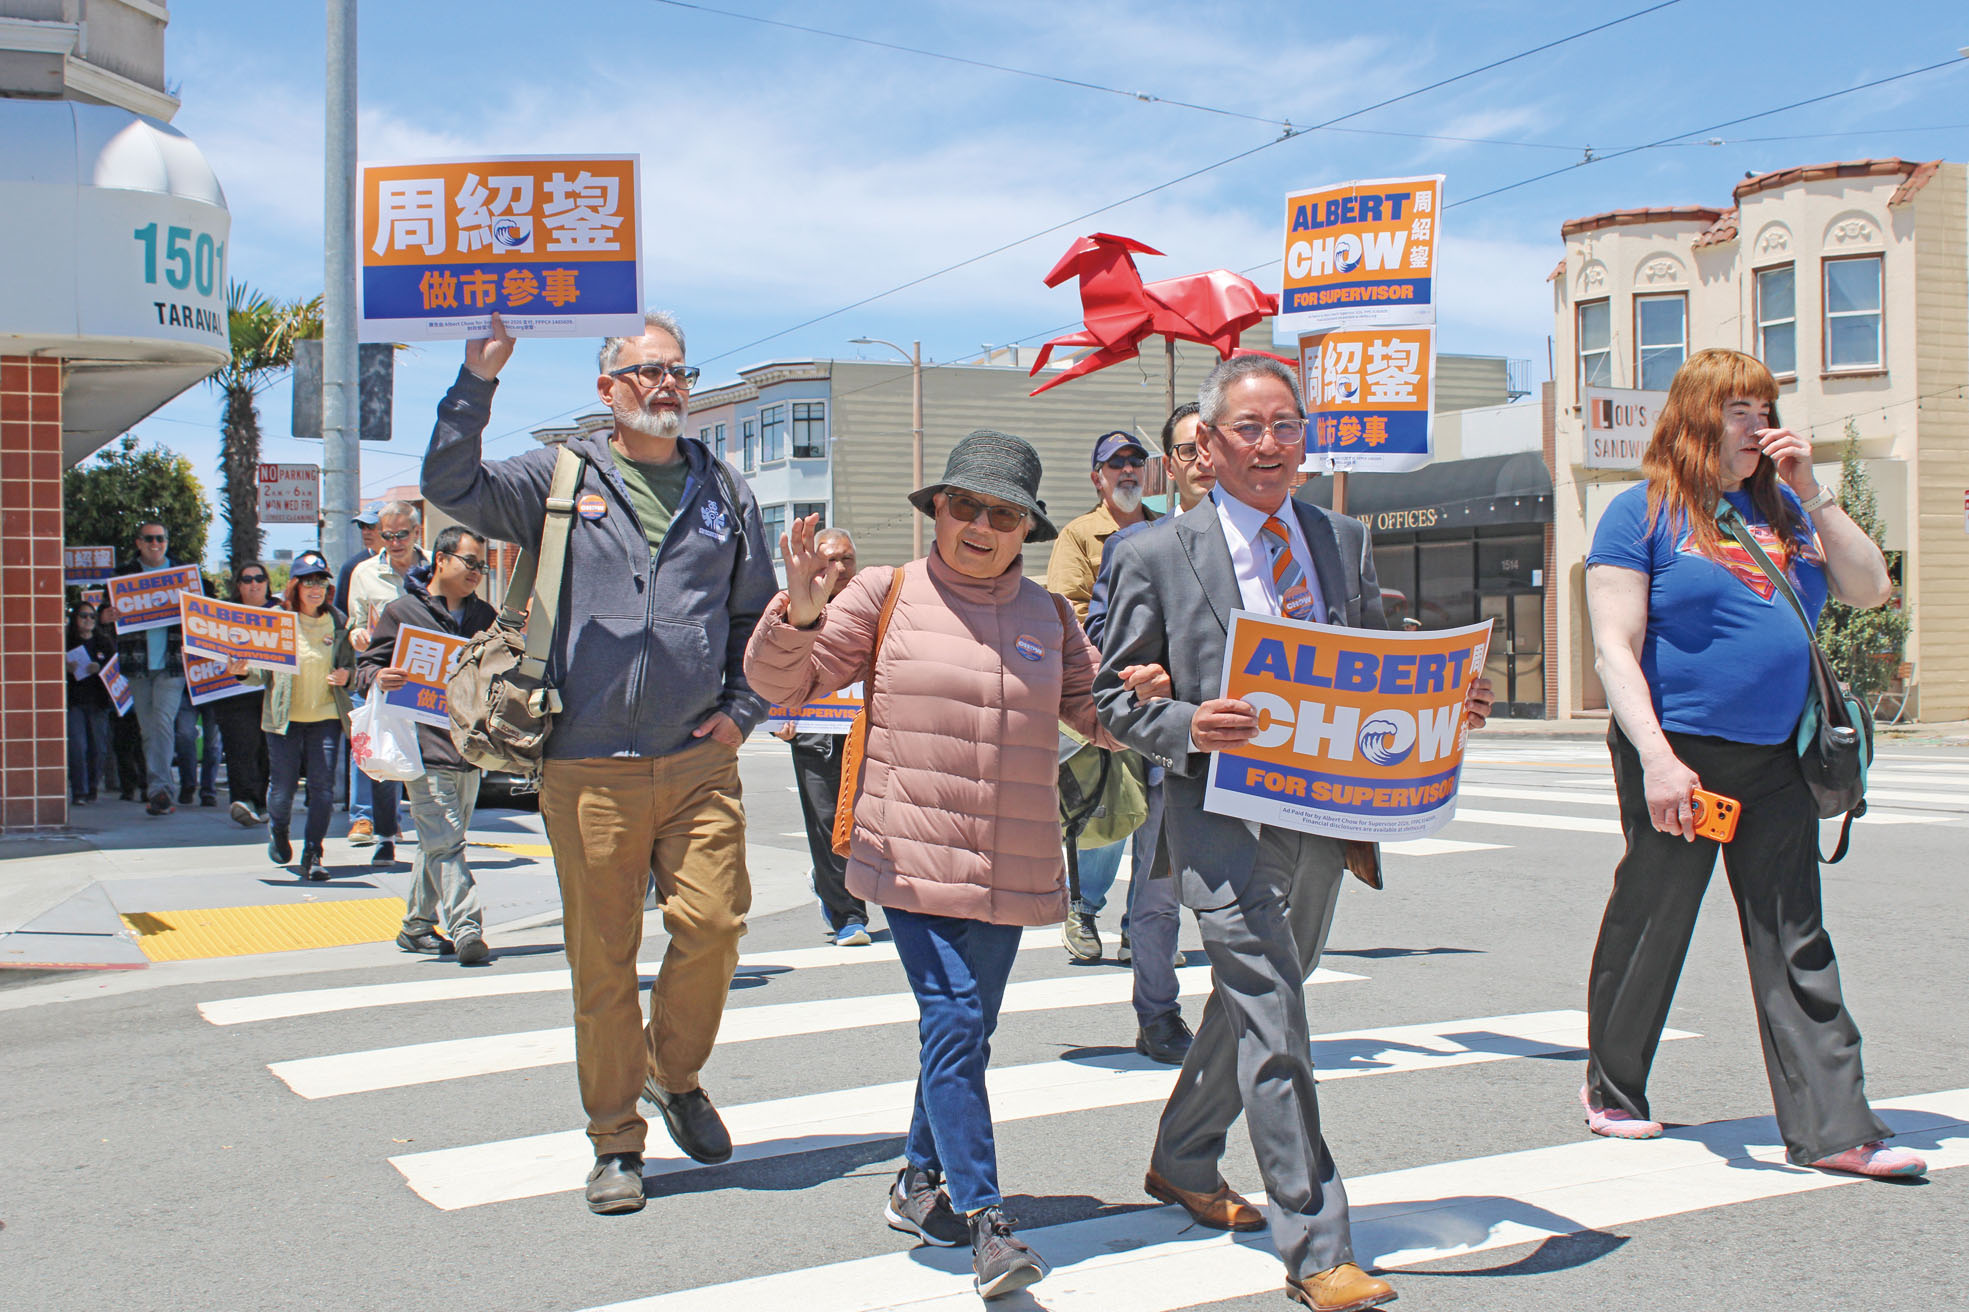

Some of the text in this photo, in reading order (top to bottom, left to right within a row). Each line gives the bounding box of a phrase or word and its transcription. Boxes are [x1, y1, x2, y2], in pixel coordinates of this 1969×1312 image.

[372, 171, 624, 256] 周紹鋆
[1292, 193, 1411, 233] ALBERT
[134, 222, 224, 301] 1501
[1288, 231, 1408, 279] CHOW
[419, 268, 580, 310] 做市參事
[1294, 285, 1414, 307] FOR SUPERVISOR
[154, 301, 223, 336] TARAVAL
[261, 465, 317, 481] NO PARKING
[1378, 508, 1437, 530] OFFICES
[1502, 560, 1520, 570] 1514
[116, 571, 186, 594] ALBERT
[188, 601, 279, 628] ALBERT
[188, 616, 280, 649] CHOW
[189, 660, 227, 682] CHO
[1243, 637, 1471, 695] ALBERT
[769, 706, 857, 719] OR SUPERVIS
[1240, 691, 1463, 767] CHOW
[1246, 767, 1455, 808] FOR SUPERVISOR
[1291, 808, 1304, 816] Paid
[1341, 817, 1358, 825] Chow
[1302, 817, 1329, 827] Financial
[1329, 821, 1362, 831] disclosures
